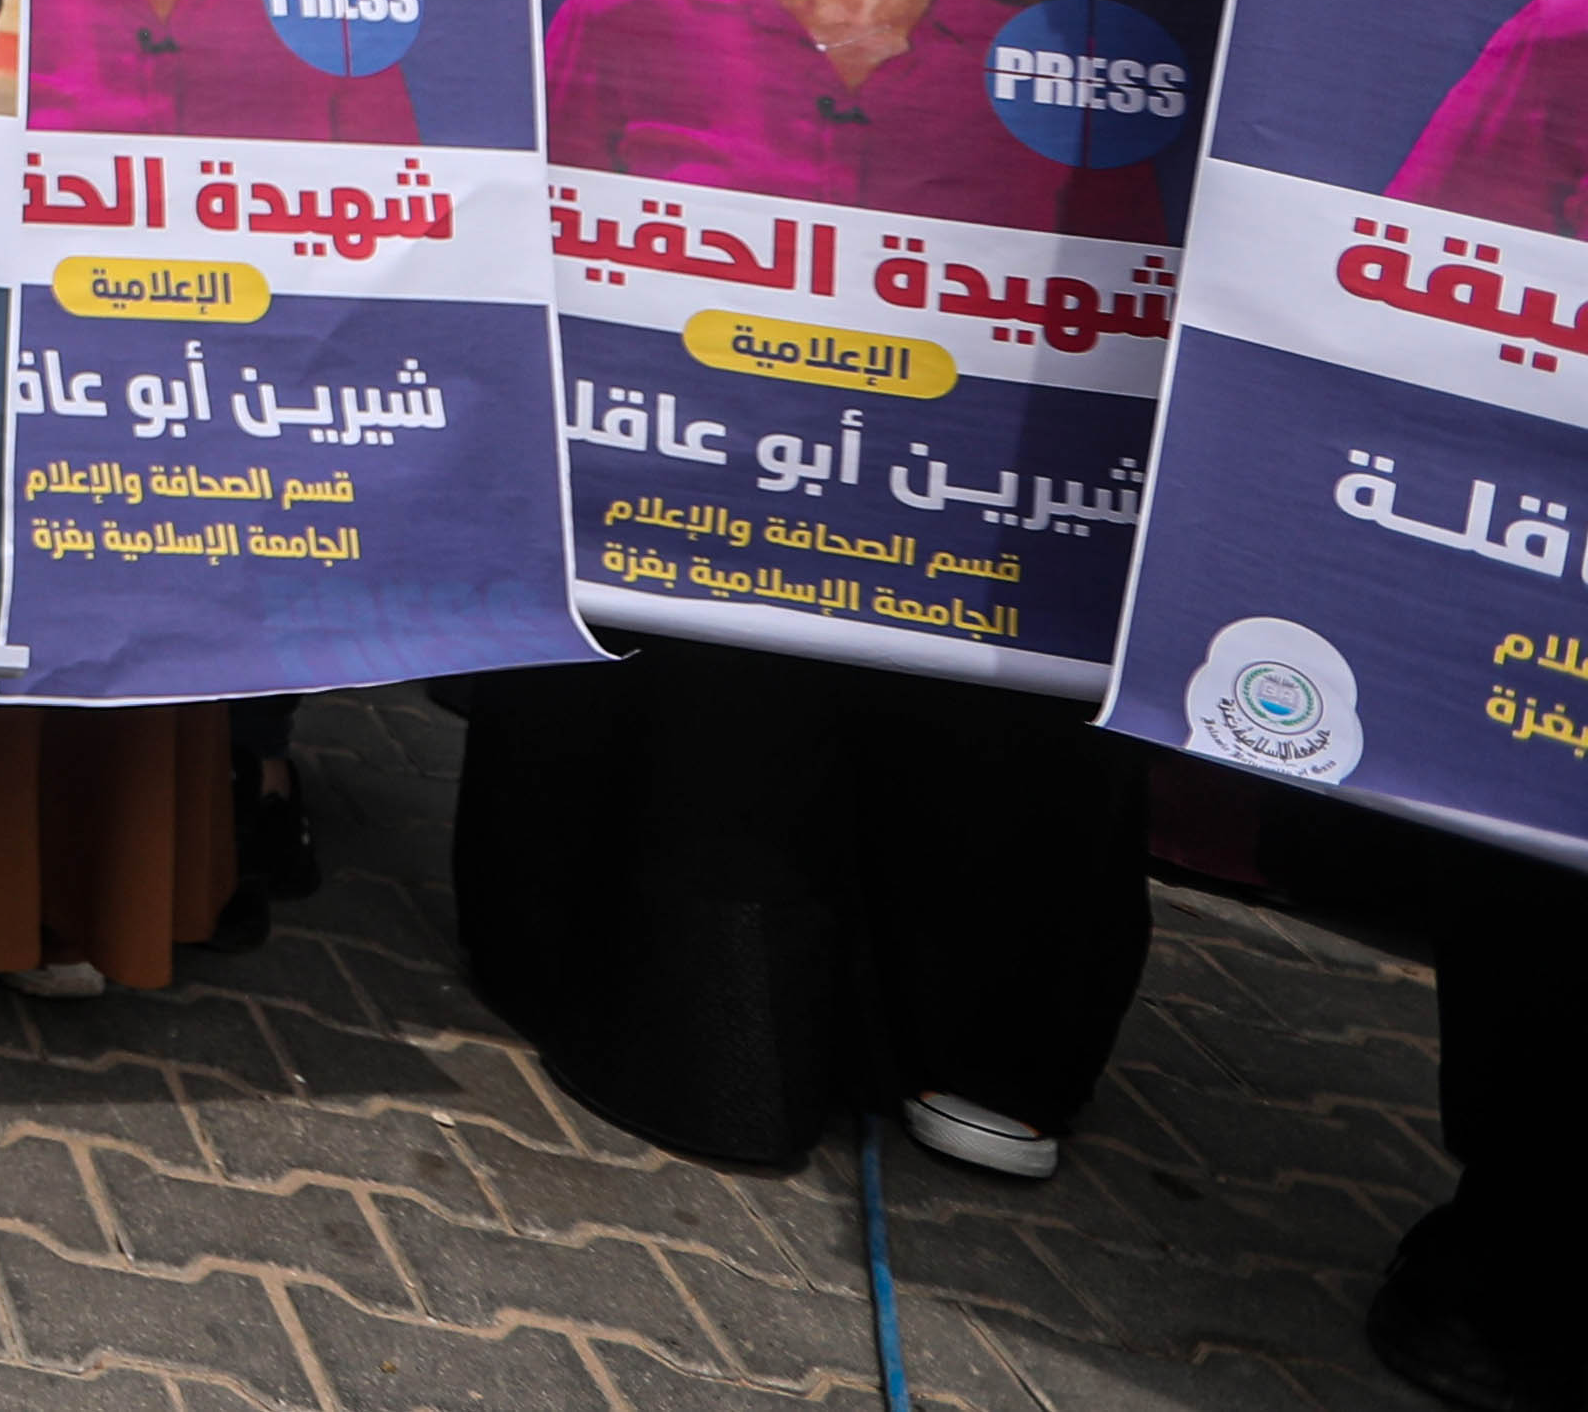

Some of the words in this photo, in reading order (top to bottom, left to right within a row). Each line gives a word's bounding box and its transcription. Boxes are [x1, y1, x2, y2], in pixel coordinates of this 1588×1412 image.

[994, 46, 1186, 118] PRESS
[196, 158, 452, 260] شهيدة
[92, 269, 230, 314] الإعلامية
[875, 235, 1174, 352] شهيدة
[16, 350, 107, 417] عاق
[732, 325, 910, 386] الإعلامية
[127, 341, 210, 437] أبو
[233, 360, 445, 445] شيرين
[567, 380, 727, 465] عاقل
[757, 410, 862, 496] أبو
[25, 462, 143, 504] والإعلام
[151, 467, 273, 499] الصحافة
[283, 473, 354, 509] قسم
[889, 442, 1145, 537] شيرين
[33, 520, 95, 559] بغزة
[605, 498, 752, 547] والإعلام
[764, 517, 916, 565] الصحافة
[1336, 450, 1570, 578] قلة
[104, 522, 240, 564] الإسلامية
[249, 527, 360, 566] الجامعة
[604, 542, 678, 588] بغزة
[927, 552, 1021, 583] قسم
[689, 557, 860, 616] الإسلامية
[873, 587, 1018, 640] الجامعة
